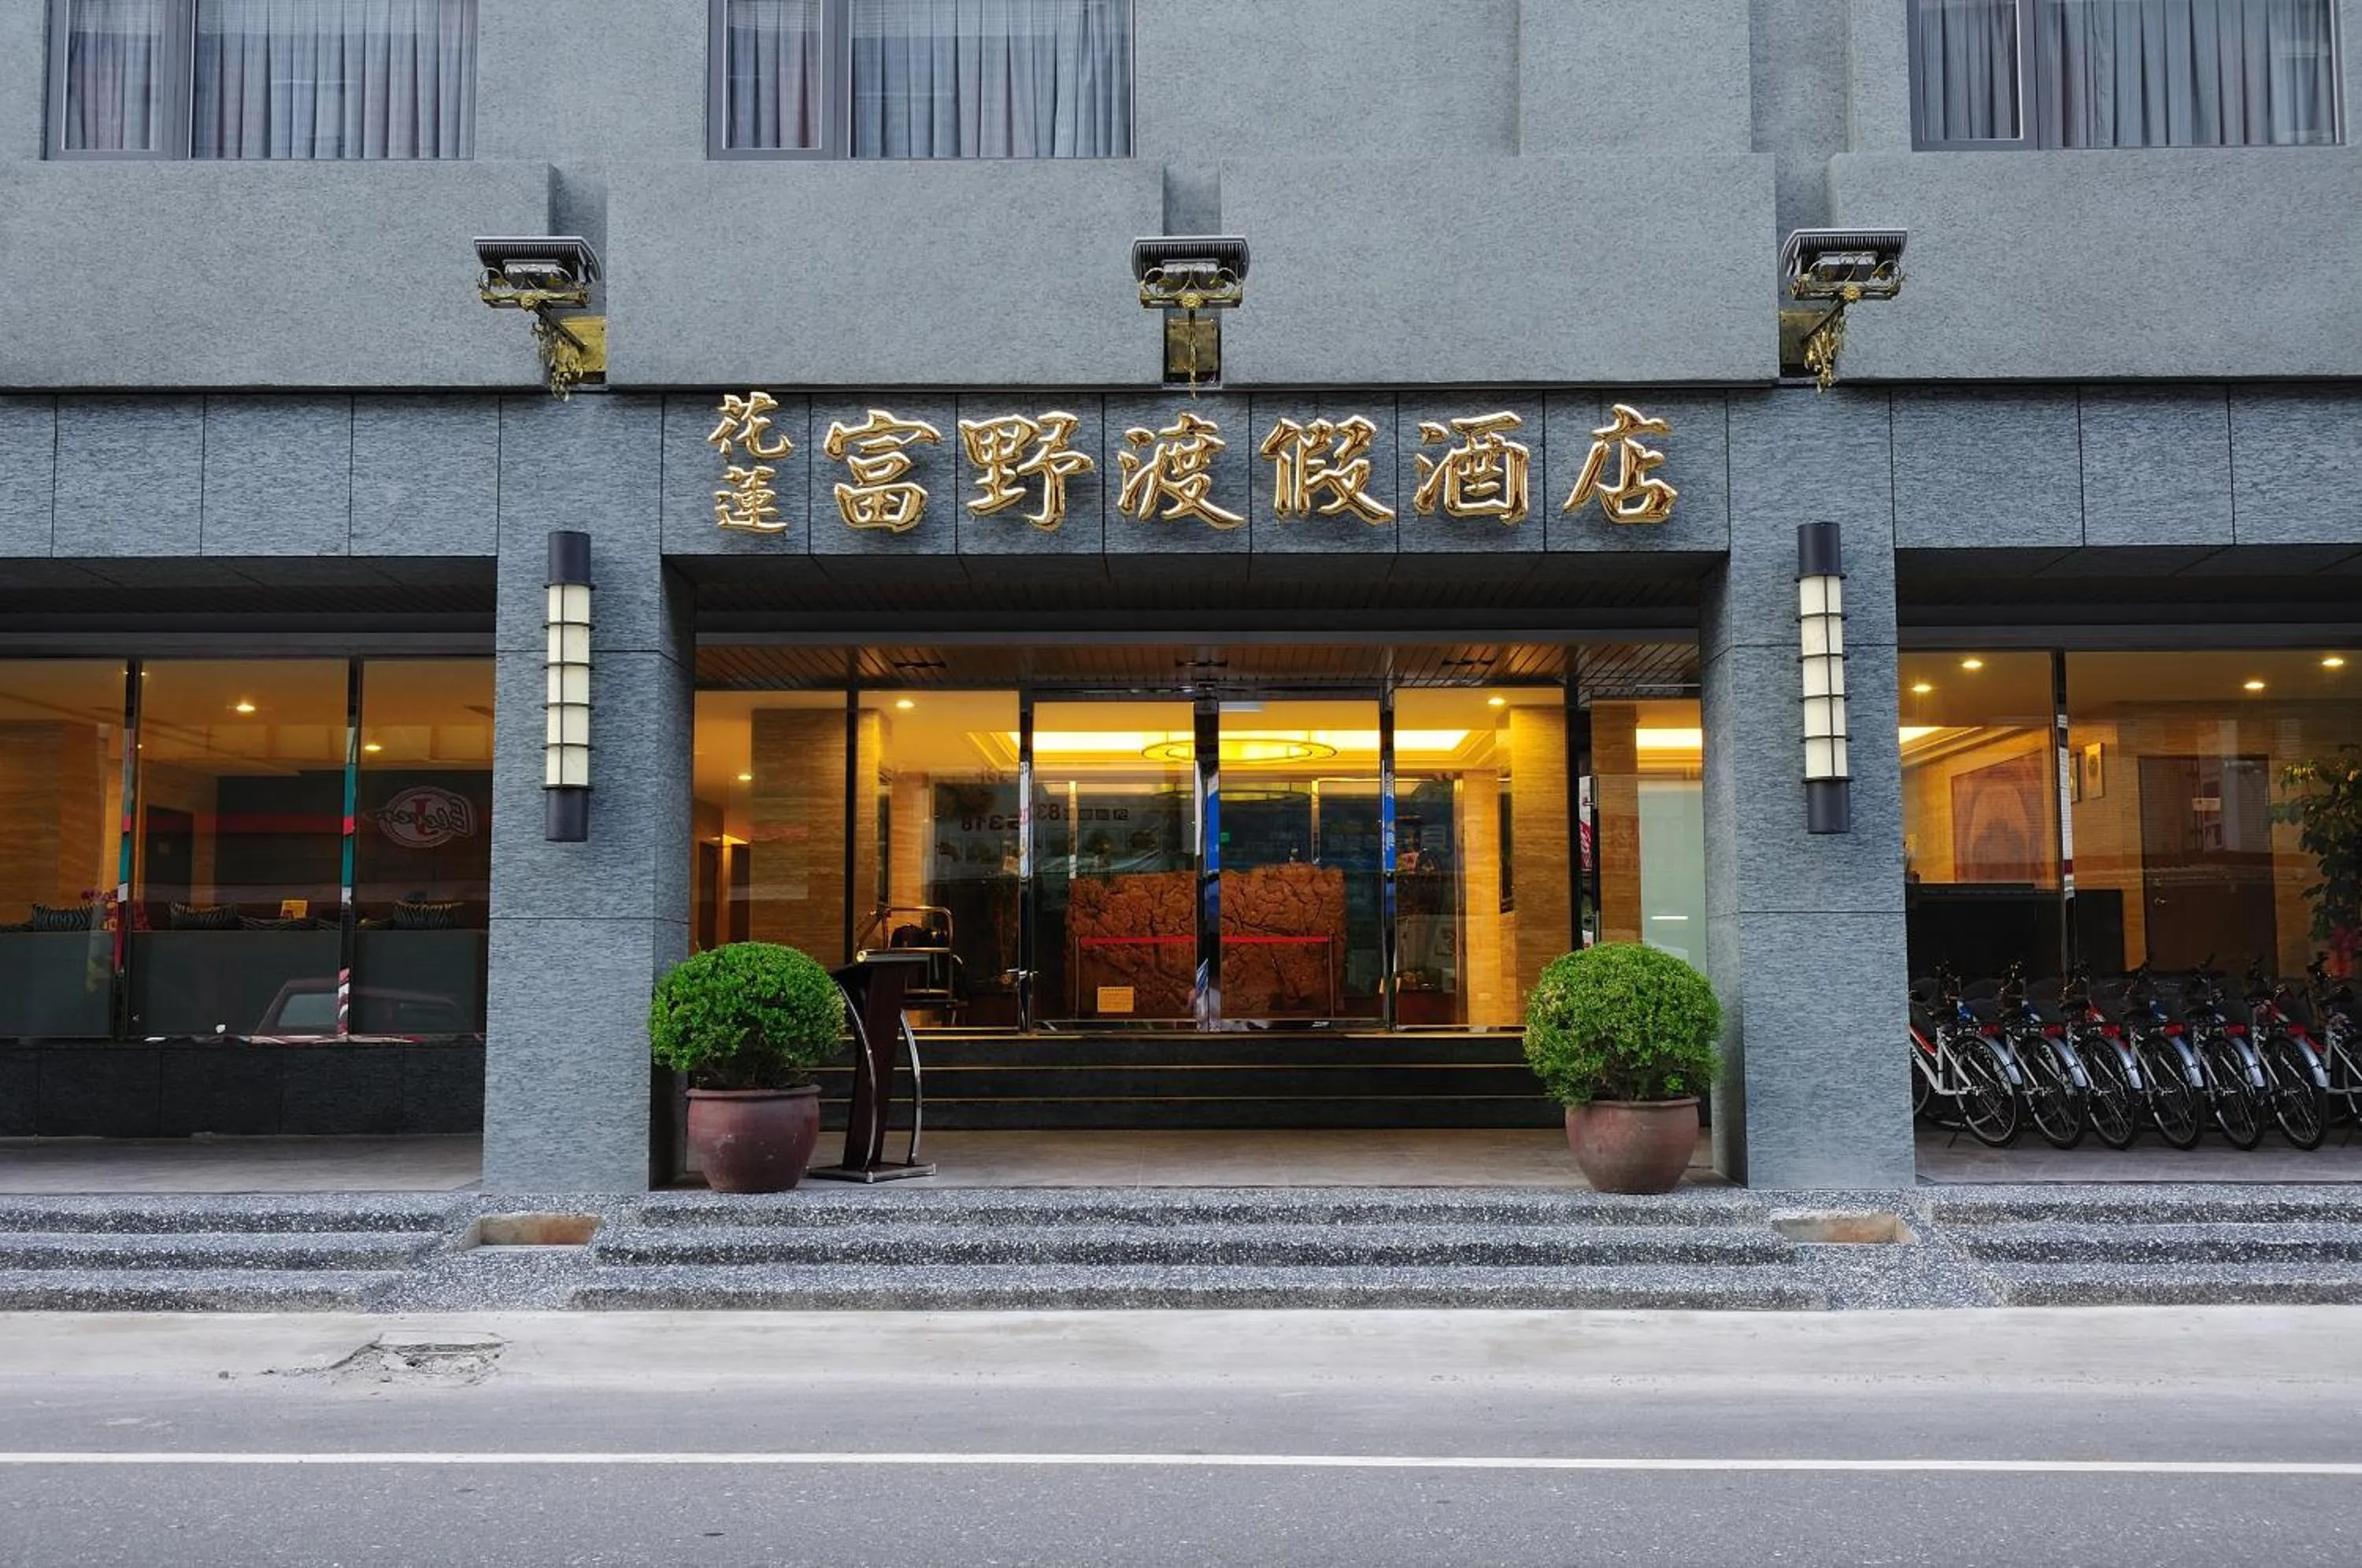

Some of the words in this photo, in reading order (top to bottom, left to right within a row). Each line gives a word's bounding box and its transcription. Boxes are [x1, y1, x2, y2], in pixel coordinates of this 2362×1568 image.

[708, 390, 794, 535] 花蓮
[822, 403, 1679, 534] 富野渡假酒店
